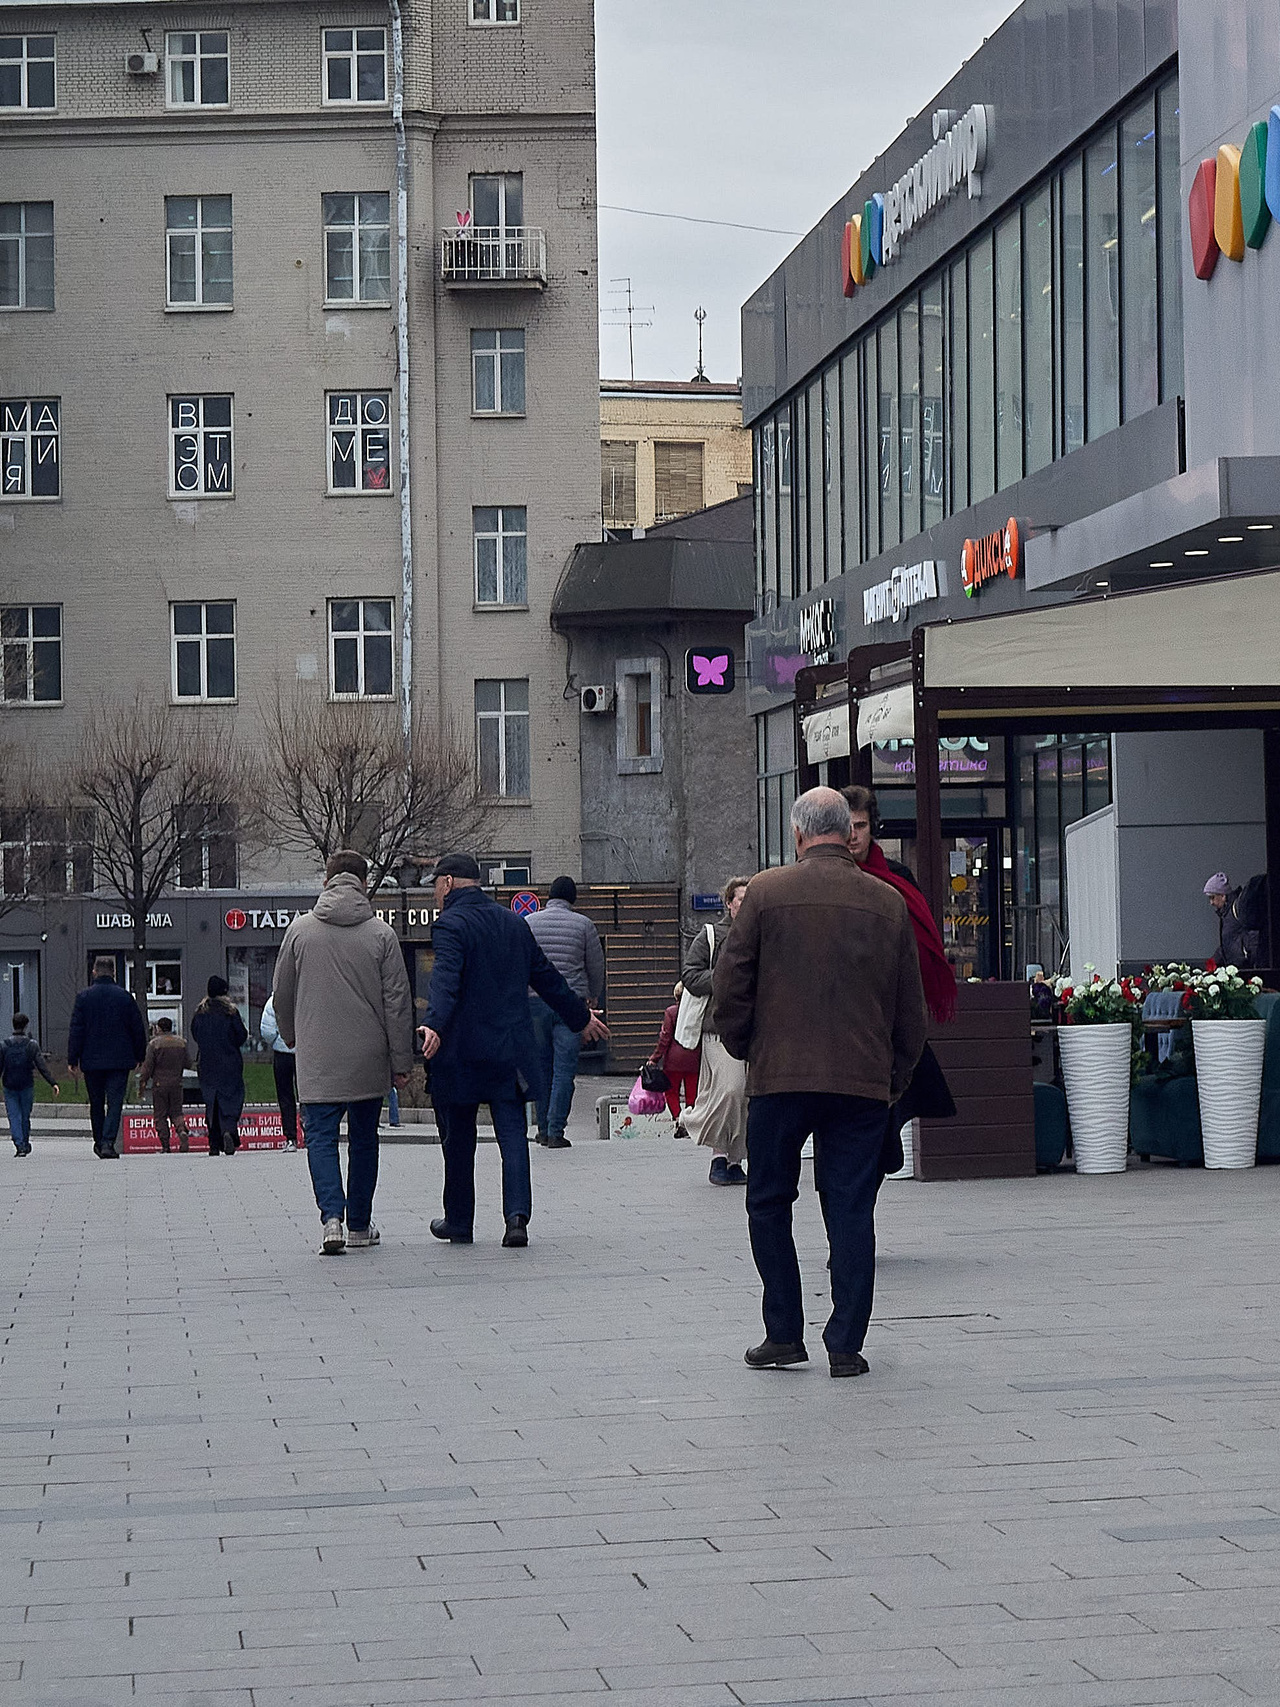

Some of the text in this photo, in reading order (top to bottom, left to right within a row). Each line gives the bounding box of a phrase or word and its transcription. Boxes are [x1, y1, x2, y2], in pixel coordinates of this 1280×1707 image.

[178, 403, 197, 429] В
[974, 528, 1007, 590] ДИКСИ
[96, 913, 173, 928] ШАВМА
